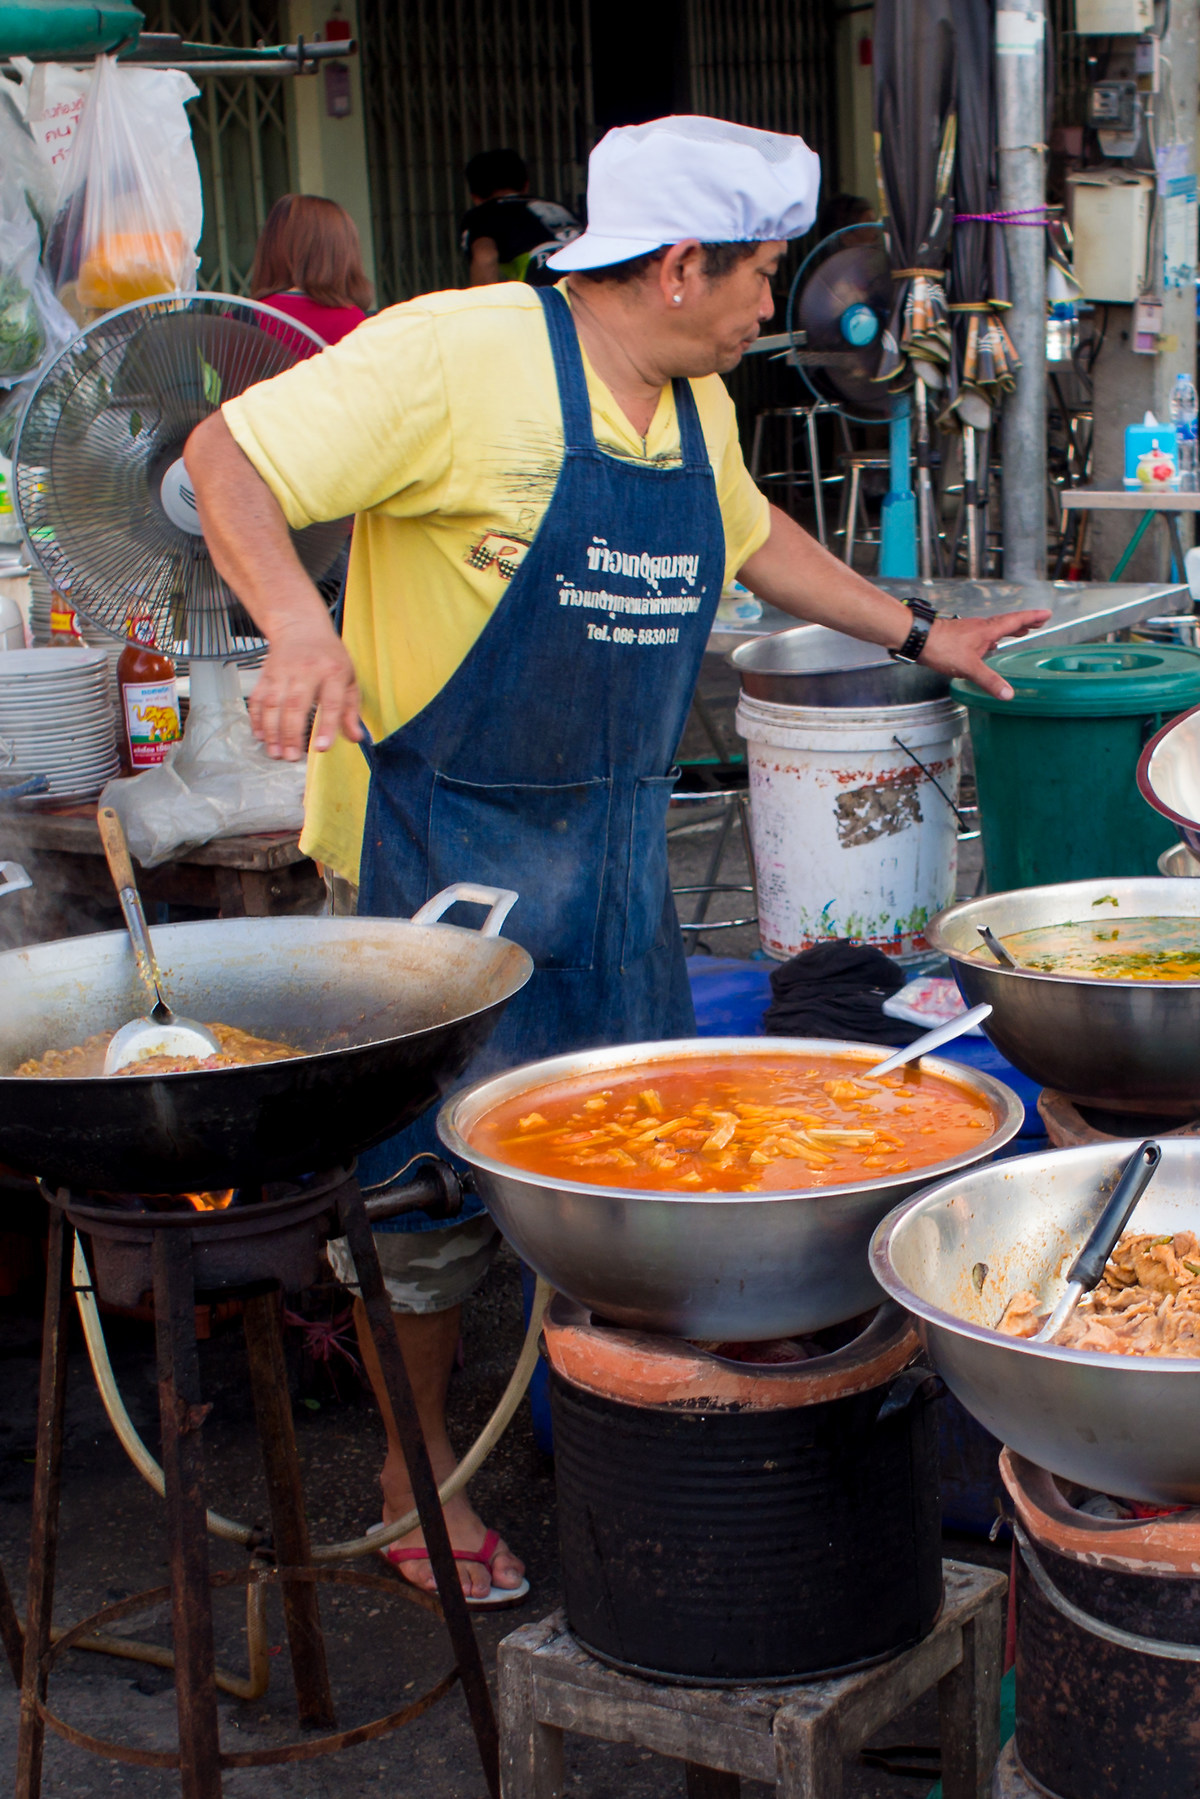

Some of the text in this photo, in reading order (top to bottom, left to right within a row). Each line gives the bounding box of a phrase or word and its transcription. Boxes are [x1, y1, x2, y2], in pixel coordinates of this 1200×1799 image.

[586, 536, 700, 590] ข้าวแกงคุณหมู
[587, 623, 611, 642] Tel.
